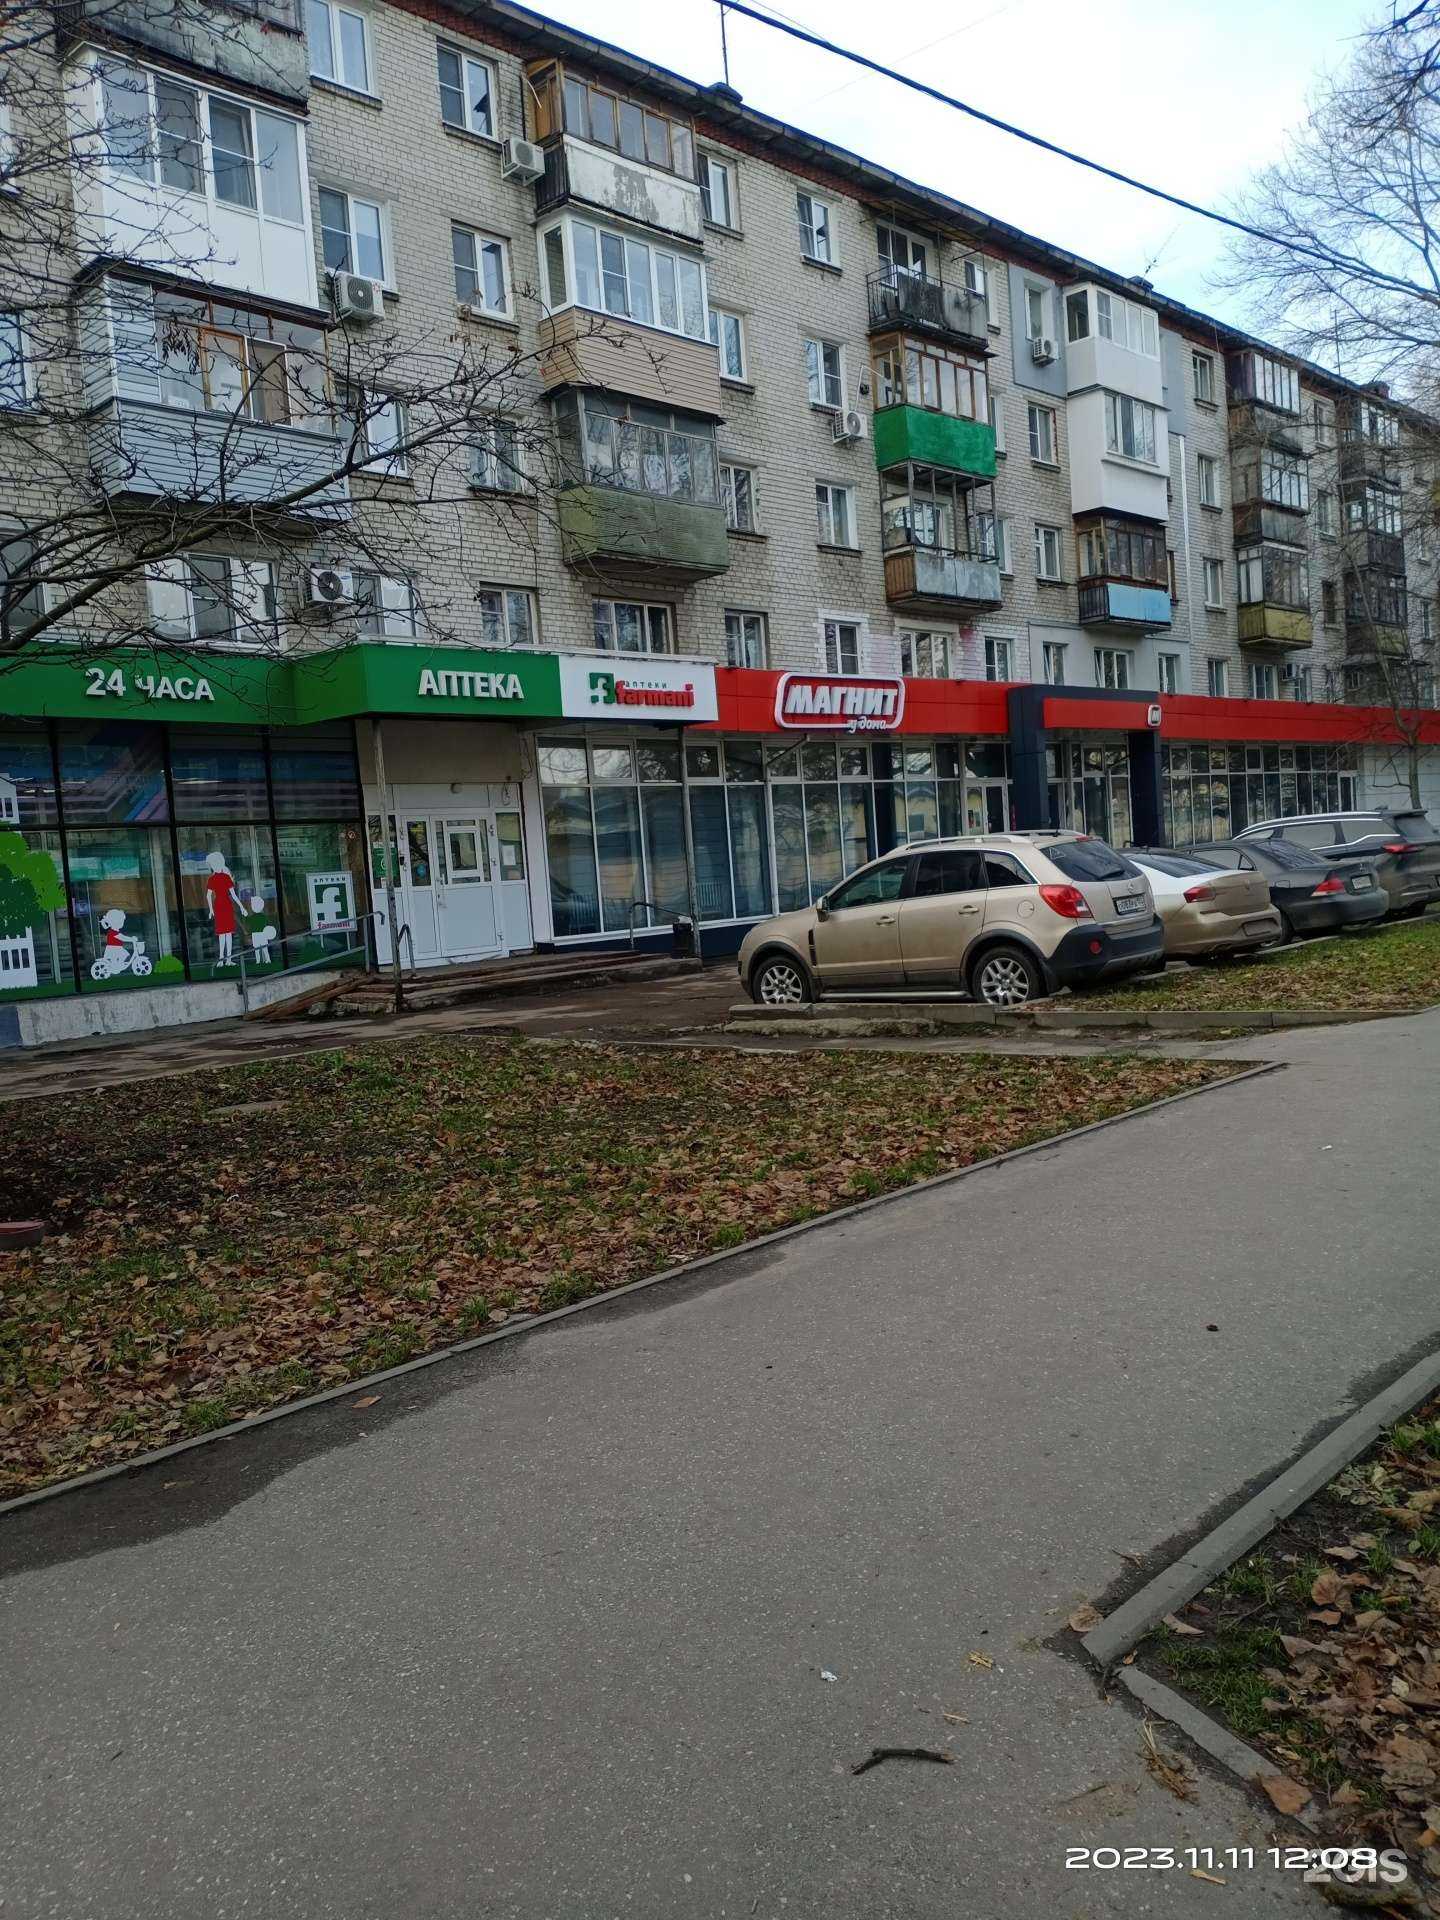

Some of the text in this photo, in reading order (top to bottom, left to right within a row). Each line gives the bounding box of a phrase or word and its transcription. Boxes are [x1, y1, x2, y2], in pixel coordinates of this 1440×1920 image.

[85, 667, 215, 701] 24 ЧАСА
[418, 669, 524, 699] АПТЕКА
[615, 680, 695, 707] farmani
[625, 680, 668, 689] аптеки
[784, 684, 898, 715] МАГНИТ
[847, 716, 887, 733] у дома
